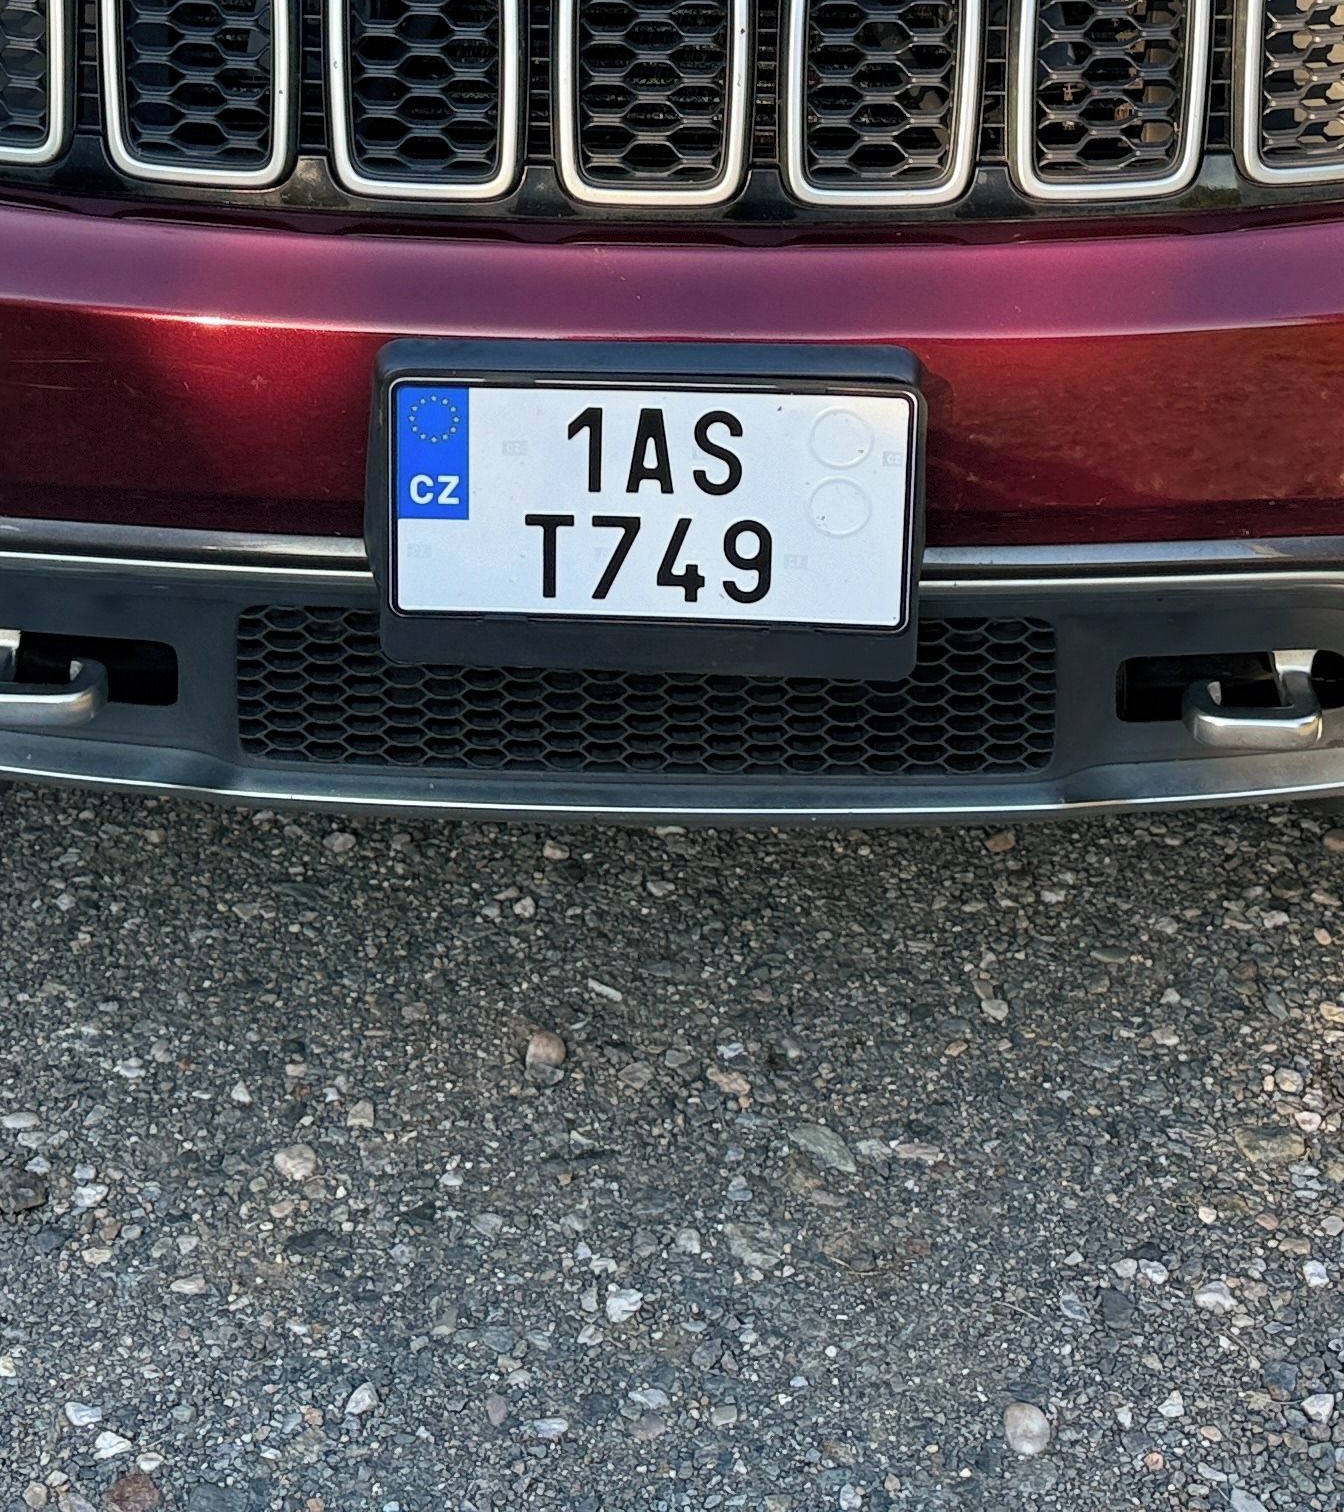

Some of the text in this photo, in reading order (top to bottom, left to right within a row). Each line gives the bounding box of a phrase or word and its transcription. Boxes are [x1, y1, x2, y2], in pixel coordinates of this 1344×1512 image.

[409, 474, 460, 505] CZ
[567, 407, 744, 496] 1AS
[524, 513, 773, 604] T749
